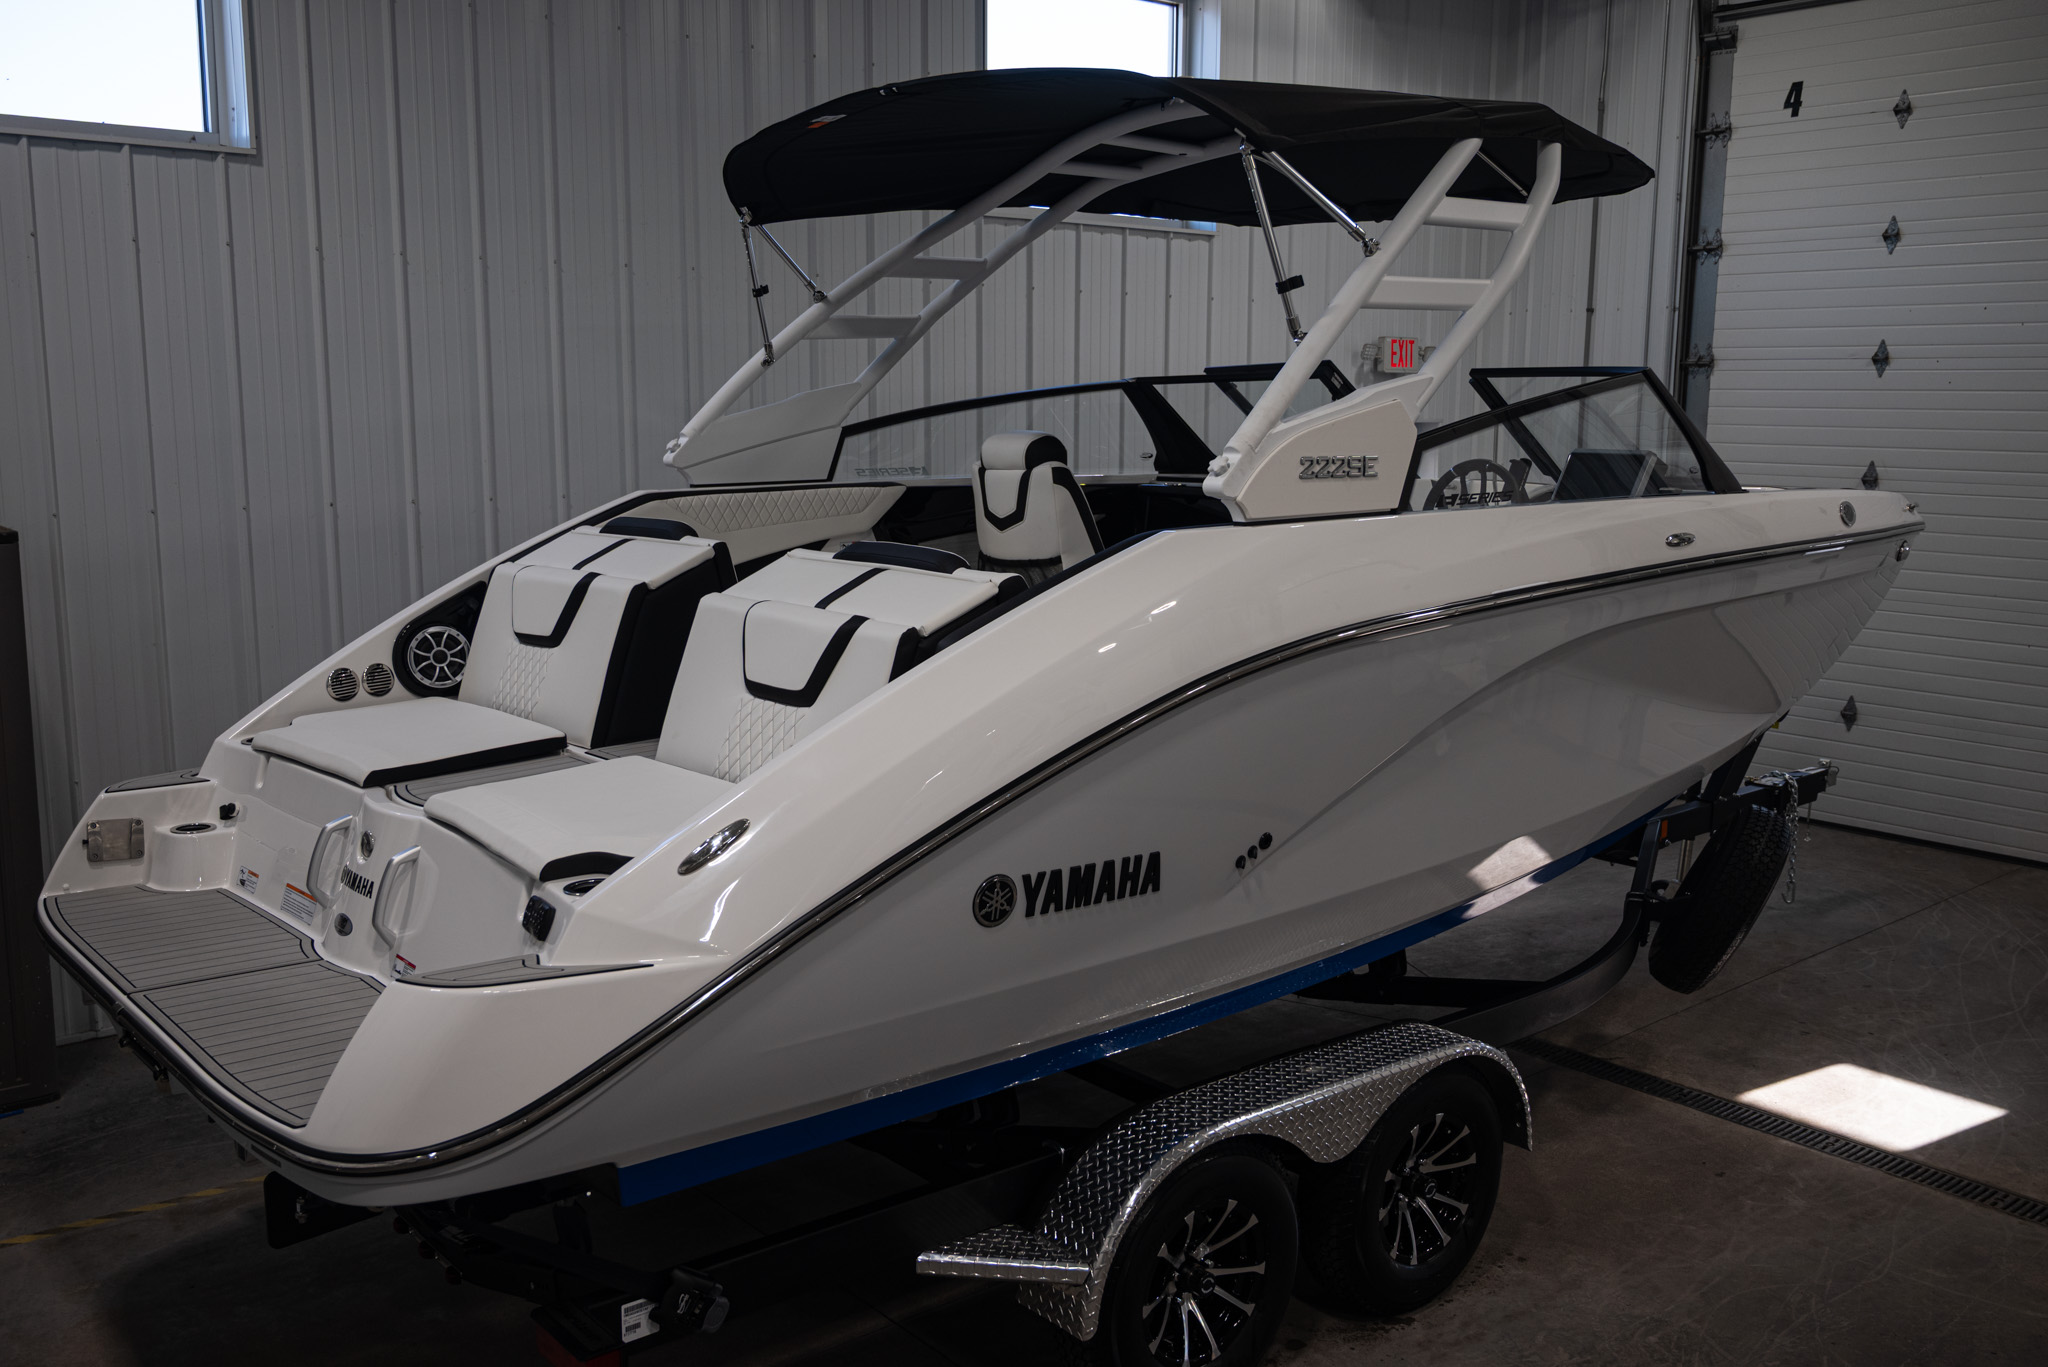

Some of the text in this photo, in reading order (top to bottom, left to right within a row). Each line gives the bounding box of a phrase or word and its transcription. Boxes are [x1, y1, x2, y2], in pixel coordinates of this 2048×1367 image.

[1783, 80, 1804, 118] 4
[1391, 339, 1415, 368] EXIT
[1298, 455, 1379, 479] 222SE
[1456, 490, 1514, 506] SERIES
[344, 868, 374, 899] YAMAHA
[1022, 851, 1161, 918] YAMAHA
